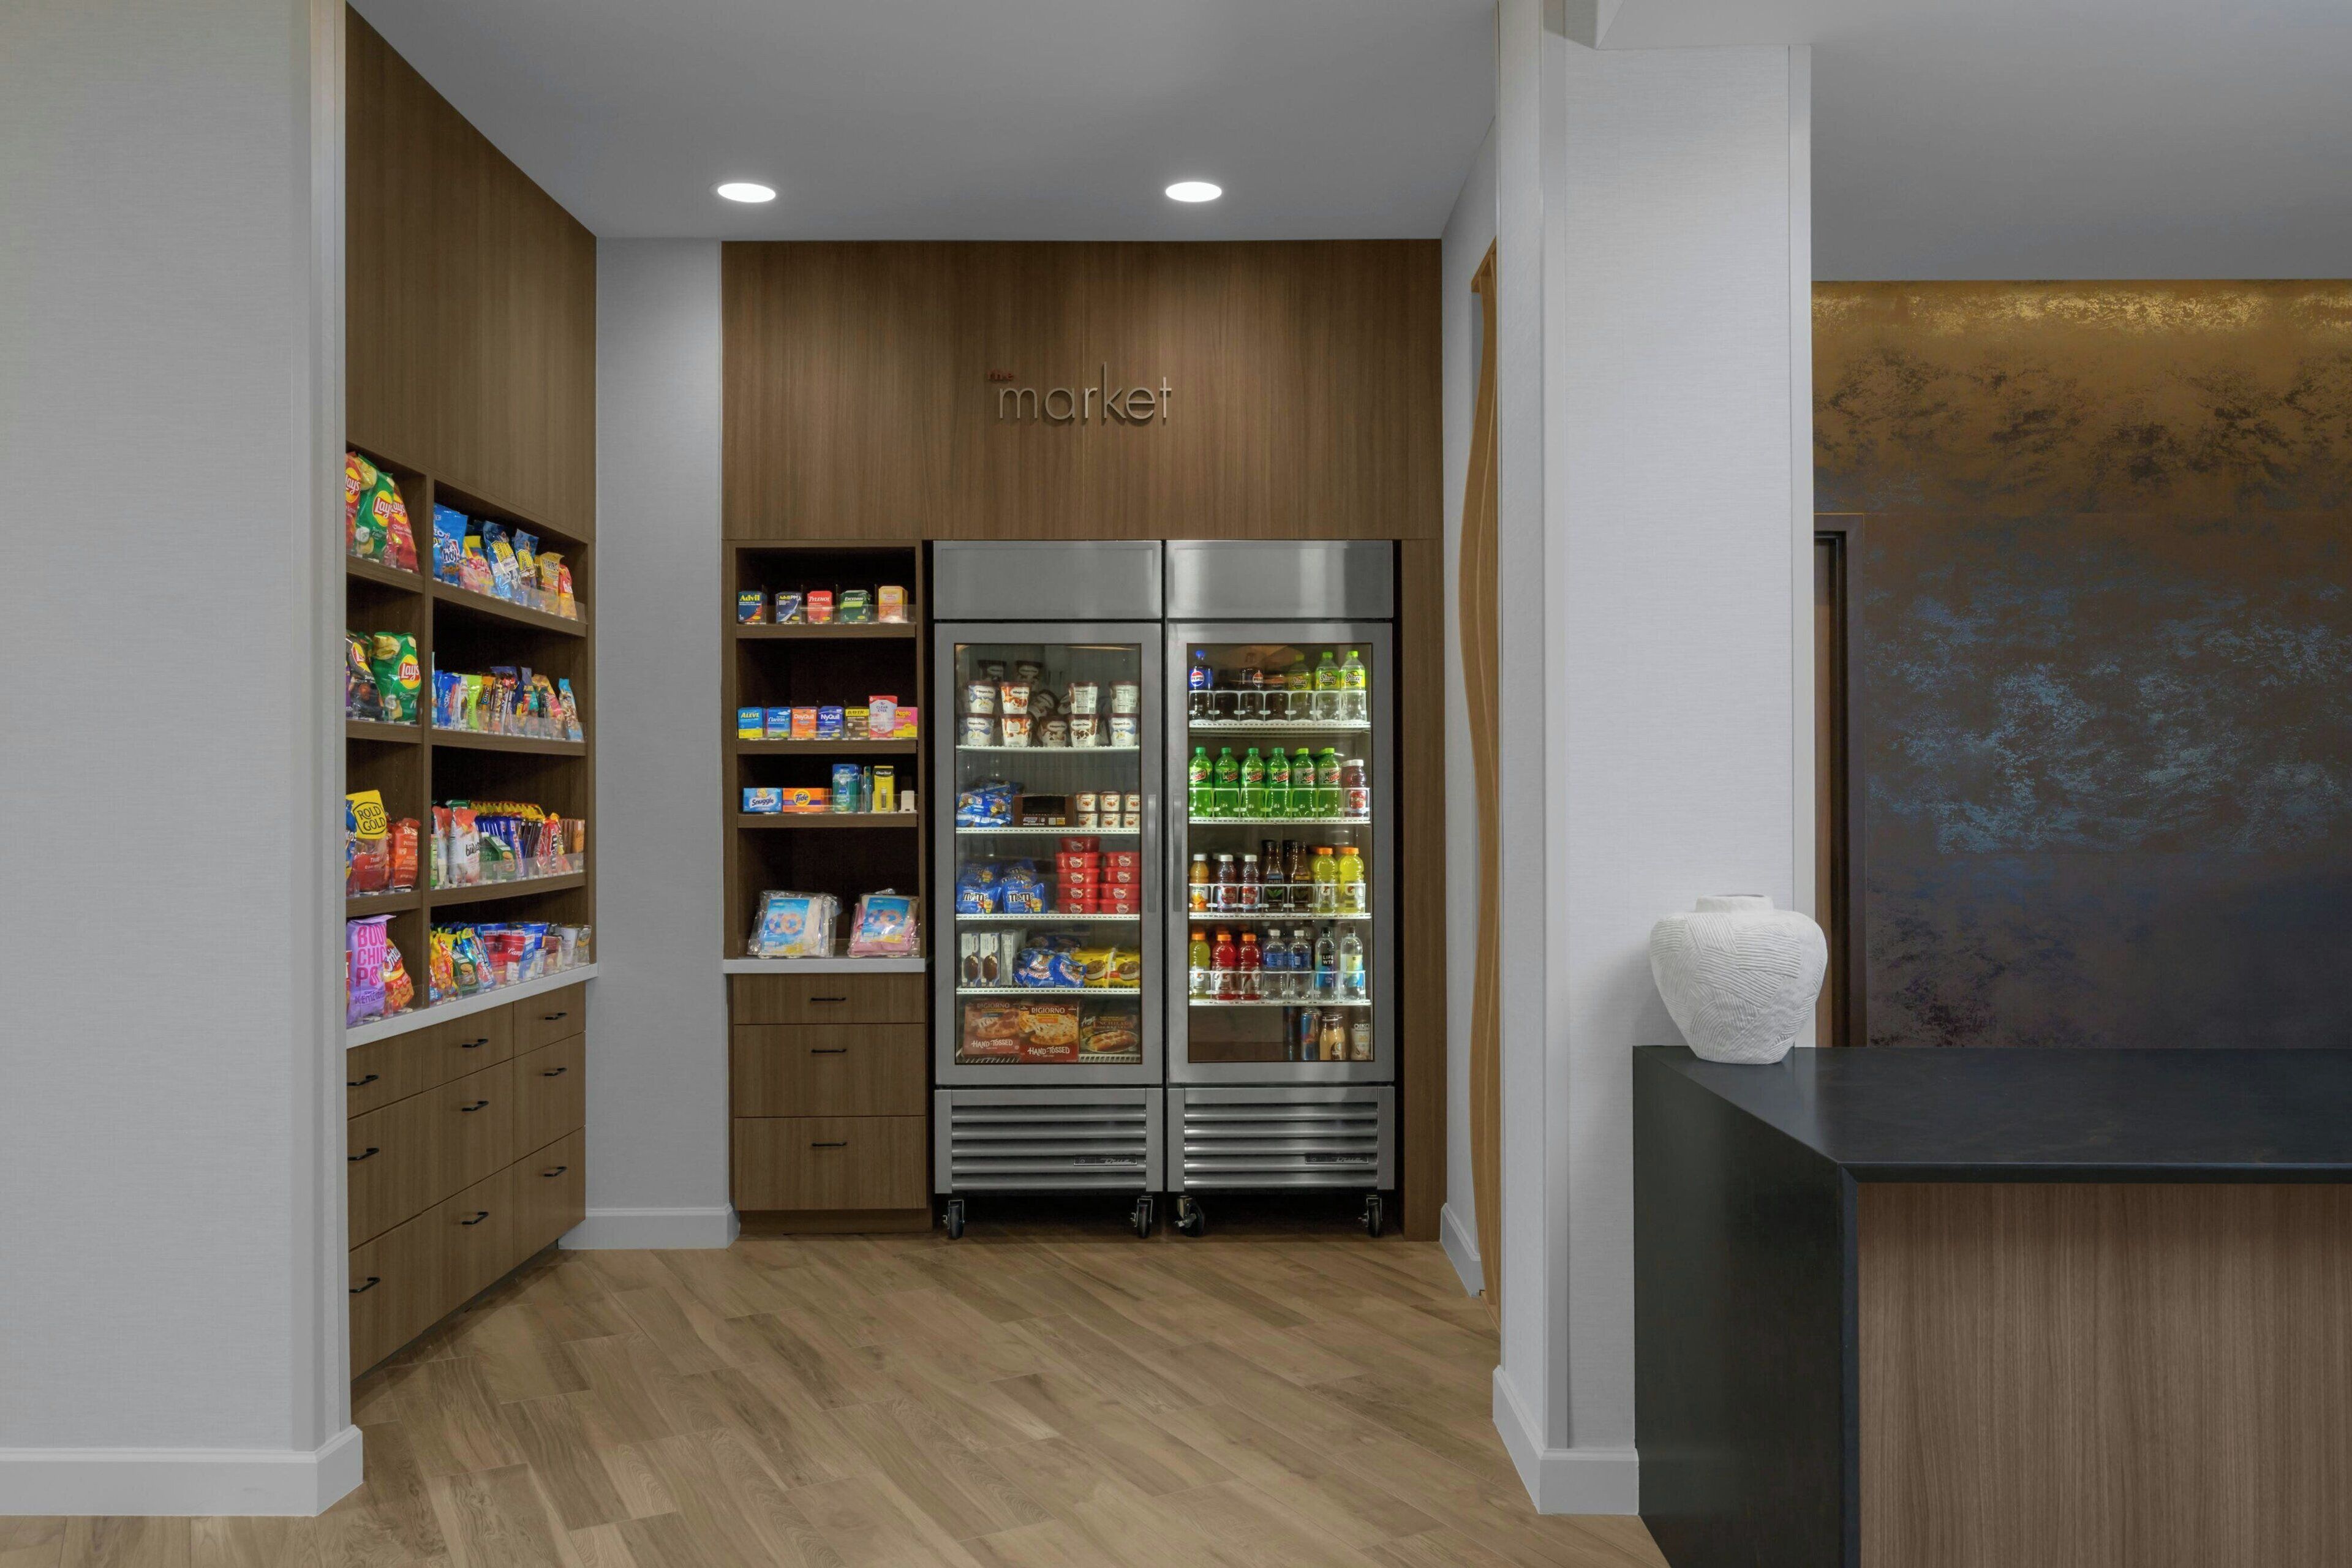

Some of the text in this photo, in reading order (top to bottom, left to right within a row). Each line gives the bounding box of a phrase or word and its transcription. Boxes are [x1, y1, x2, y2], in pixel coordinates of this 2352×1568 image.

[999, 361, 1172, 420] market
[752, 797, 774, 806] Snuggle
[795, 794, 809, 803] Tide
[357, 806, 381, 820] ROLD
[363, 817, 386, 832] GOLD
[971, 1039, 1014, 1049] HAND-TOSSED
[1027, 1046, 1070, 1056] HAND-TOSSED
